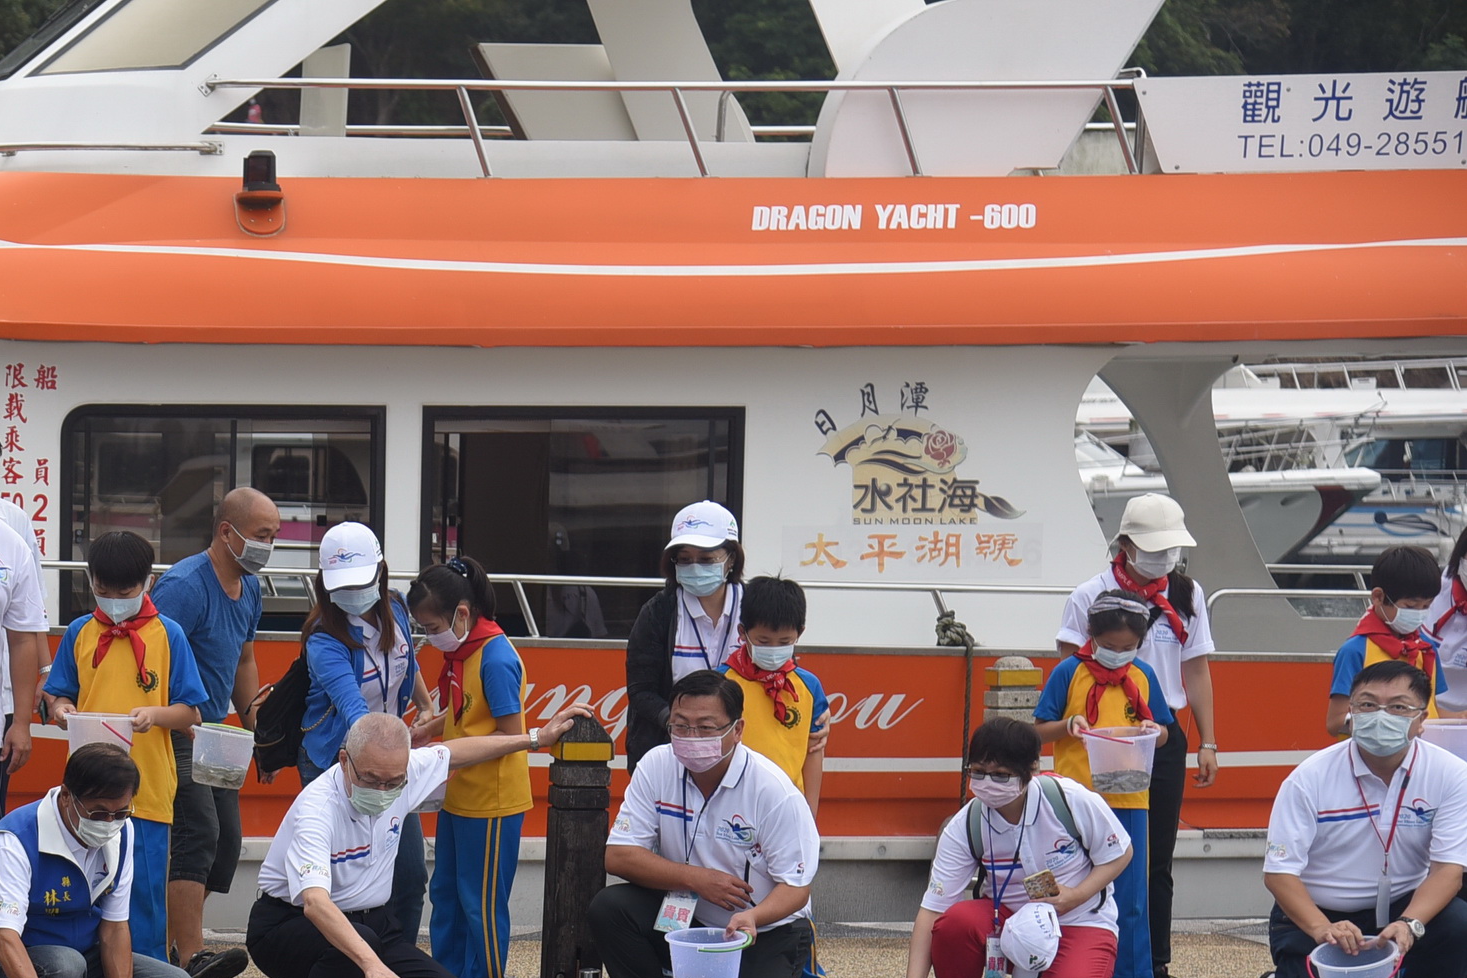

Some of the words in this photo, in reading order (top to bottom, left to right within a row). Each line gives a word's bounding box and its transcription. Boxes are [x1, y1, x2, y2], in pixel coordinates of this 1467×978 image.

[751, 204, 863, 231] DRAGON
[874, 204, 961, 230] YACHT
[852, 477, 980, 515] 水社海
[852, 517, 884, 526] SUN
[889, 517, 934, 526] MOON
[939, 517, 978, 526] LAKE
